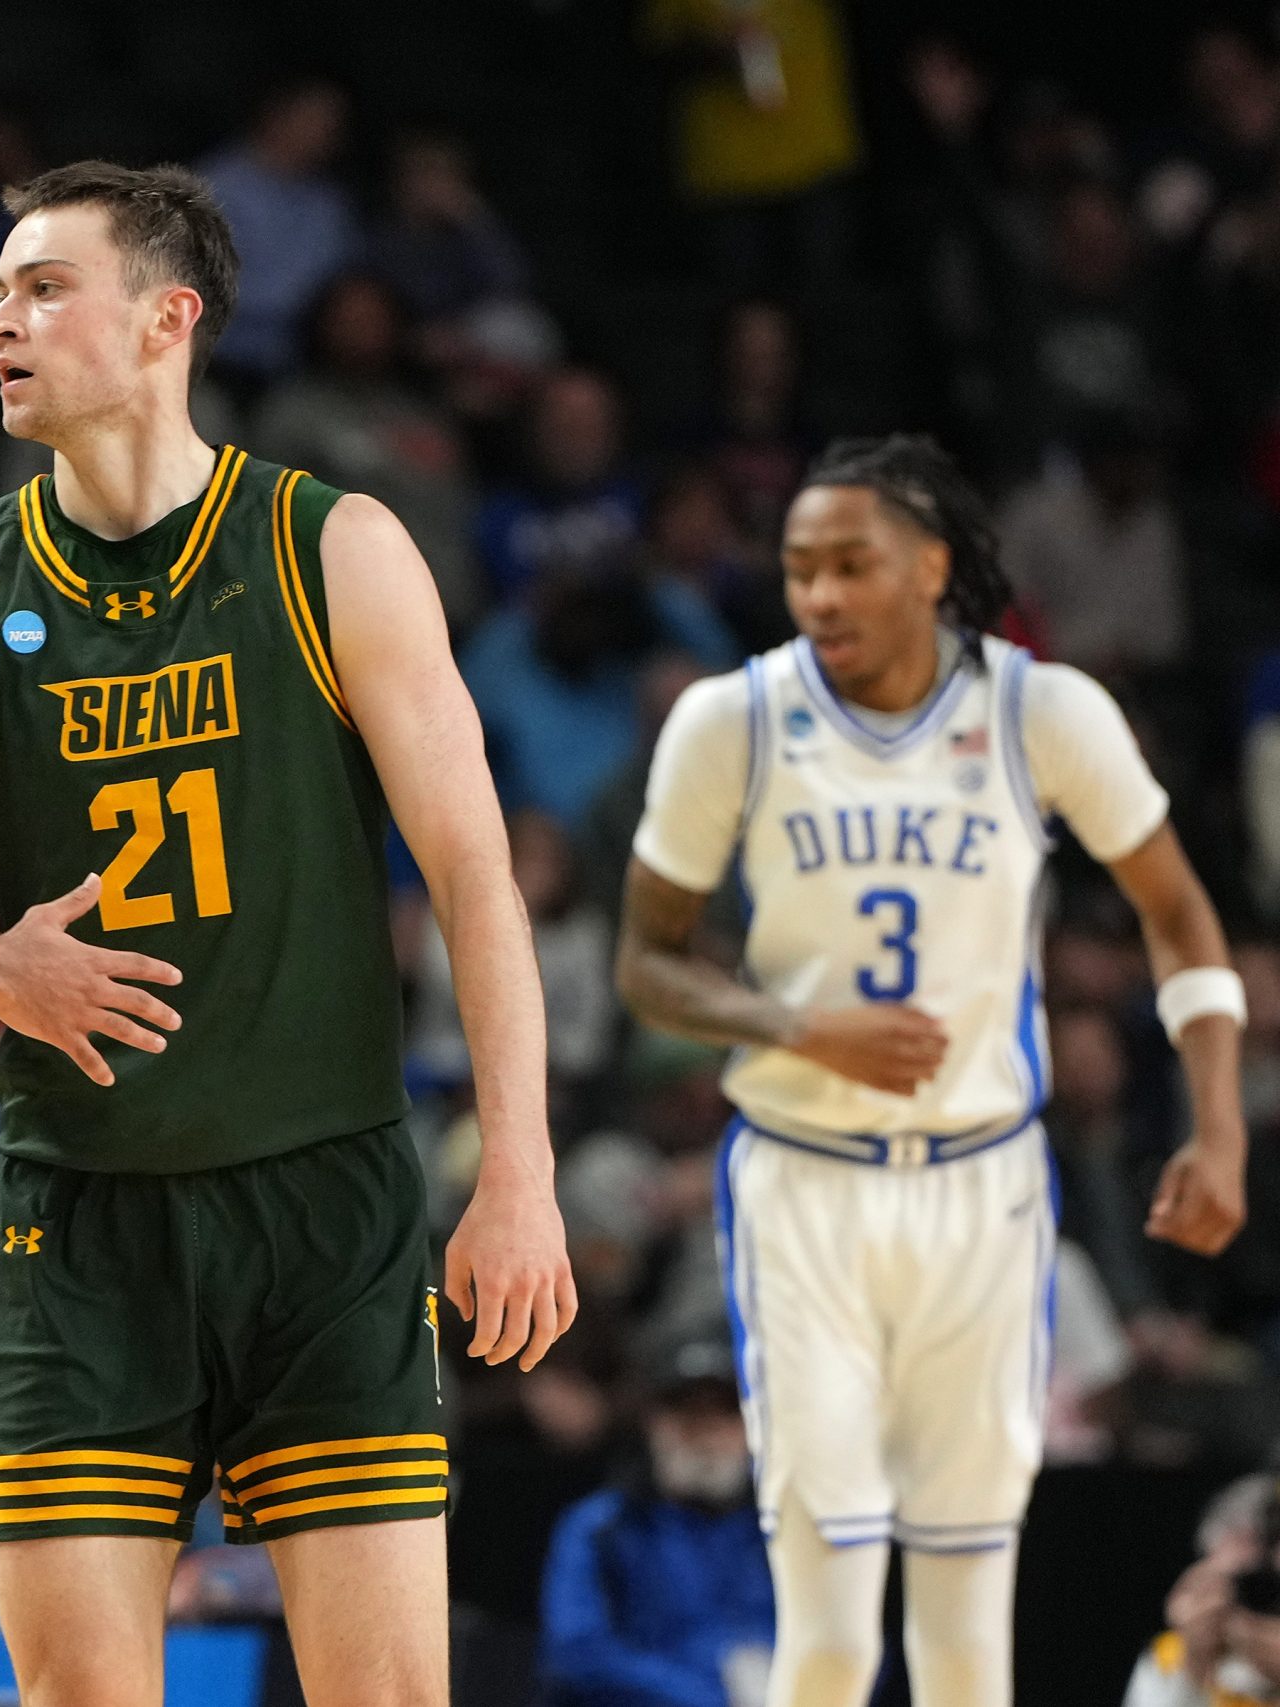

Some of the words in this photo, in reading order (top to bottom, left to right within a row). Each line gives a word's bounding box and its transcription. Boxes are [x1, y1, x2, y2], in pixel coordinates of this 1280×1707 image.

[9, 631, 44, 642] NCAA
[66, 662, 230, 754] SIENA
[88, 768, 232, 931] 21
[783, 807, 998, 874] DUKE
[857, 888, 917, 1002] 3
